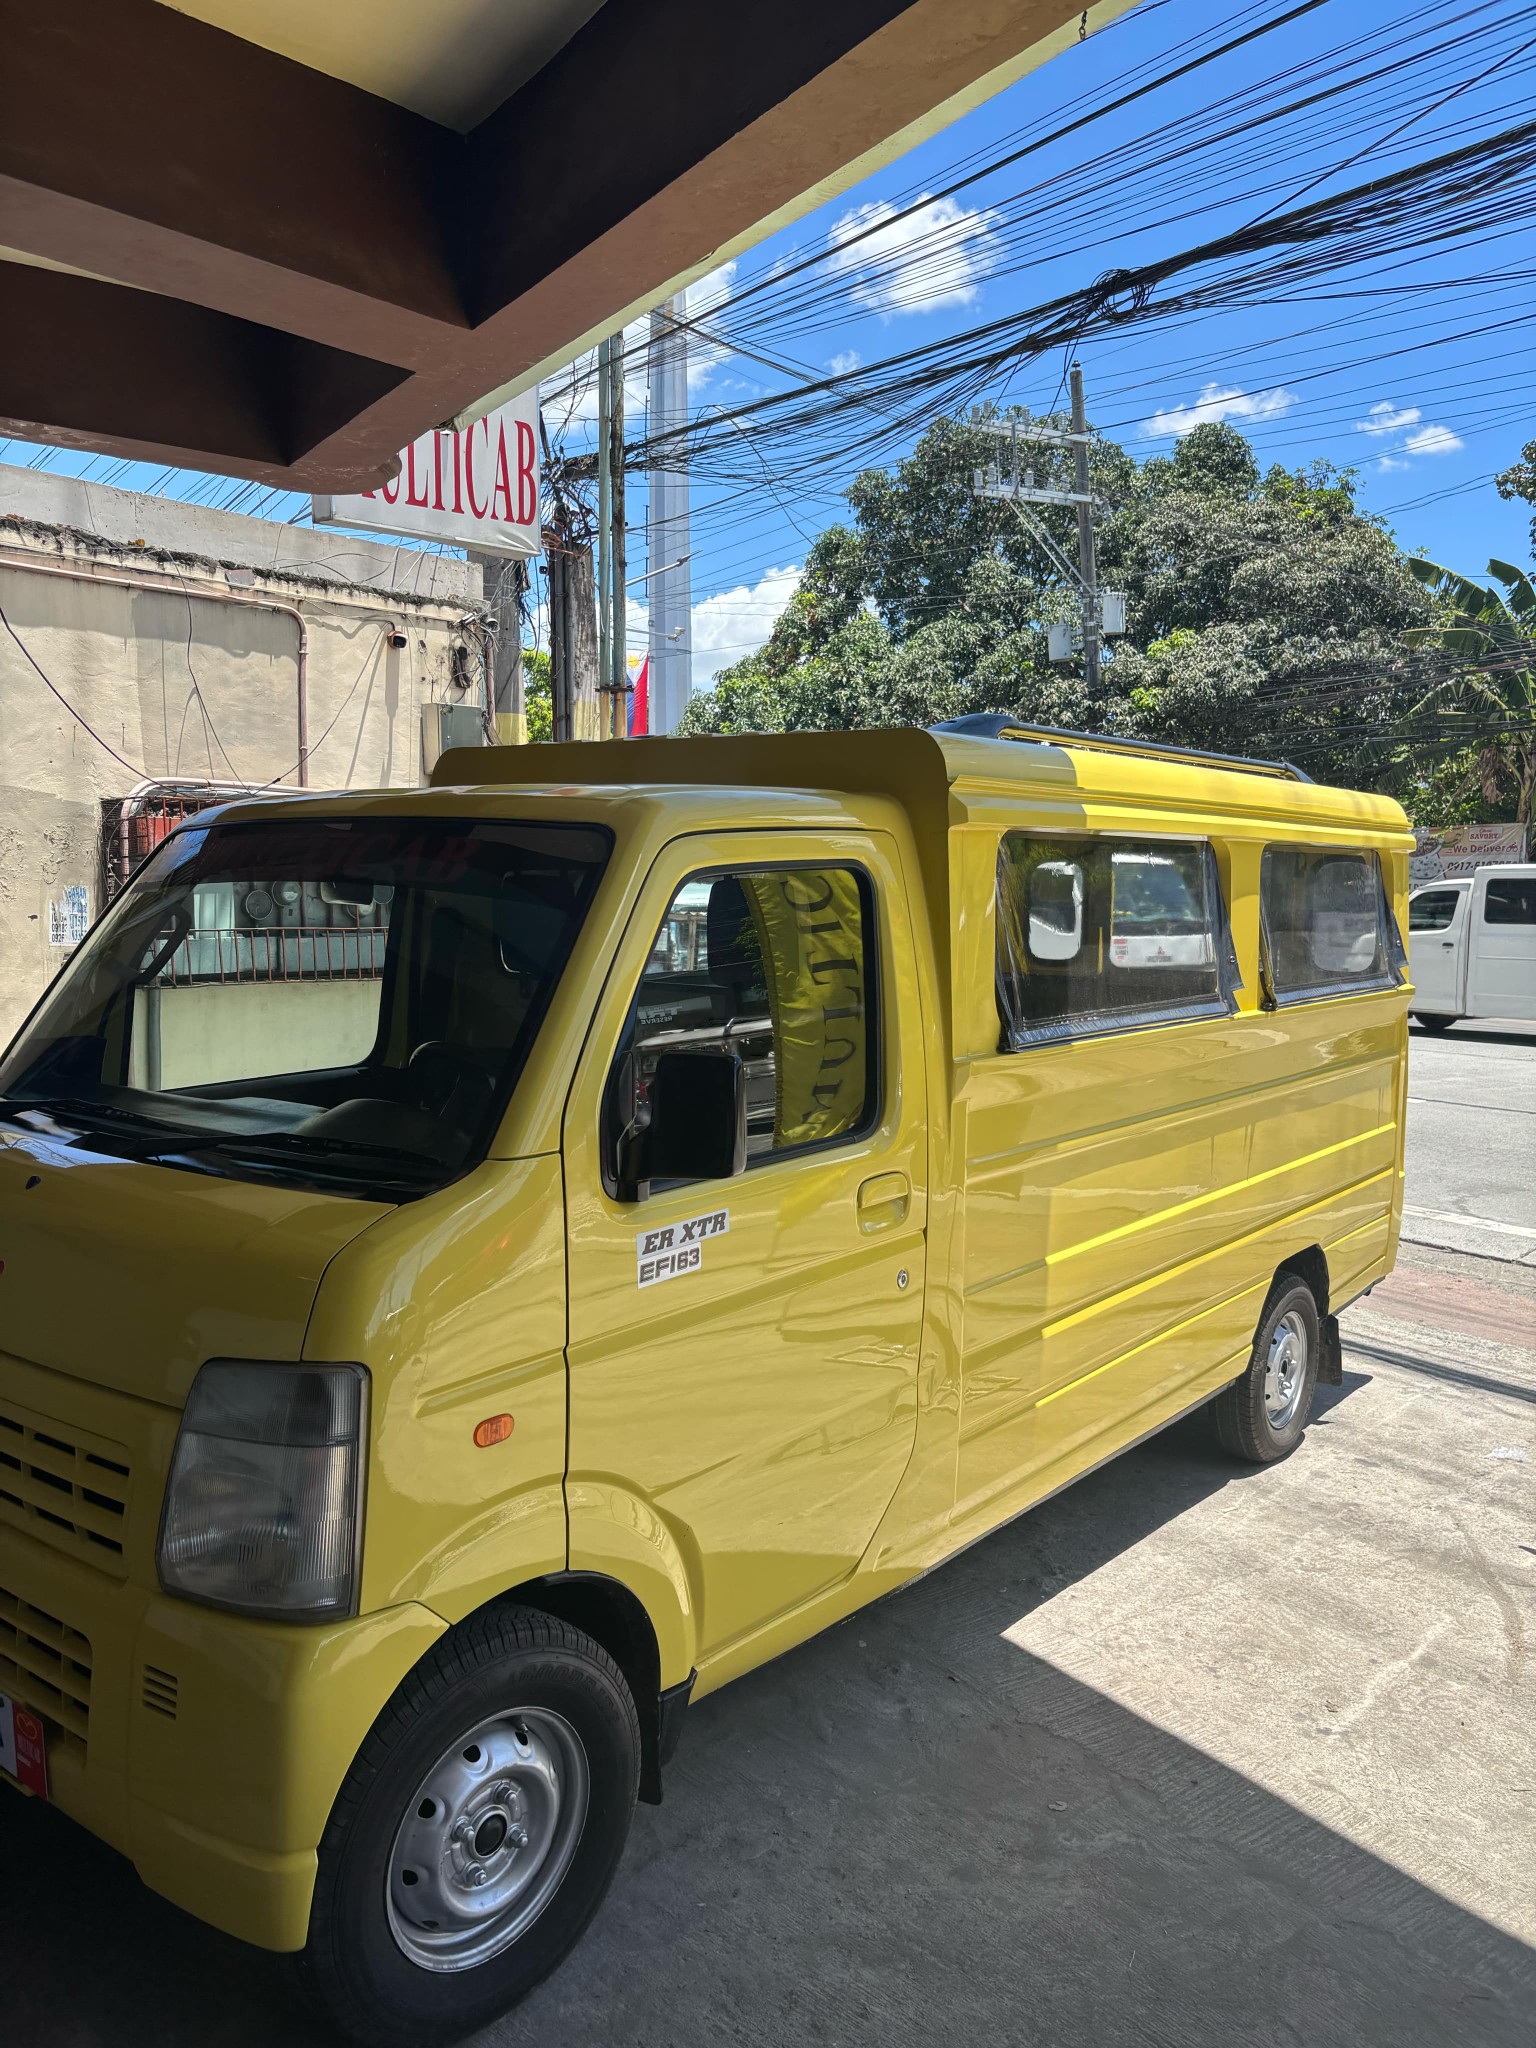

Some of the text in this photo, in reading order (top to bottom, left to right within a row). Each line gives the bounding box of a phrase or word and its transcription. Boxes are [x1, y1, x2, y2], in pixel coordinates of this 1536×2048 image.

[361, 415, 537, 526] LTICAB
[1453, 843, 1506, 854] We Deliver
[642, 1212, 726, 1255] ER XTR
